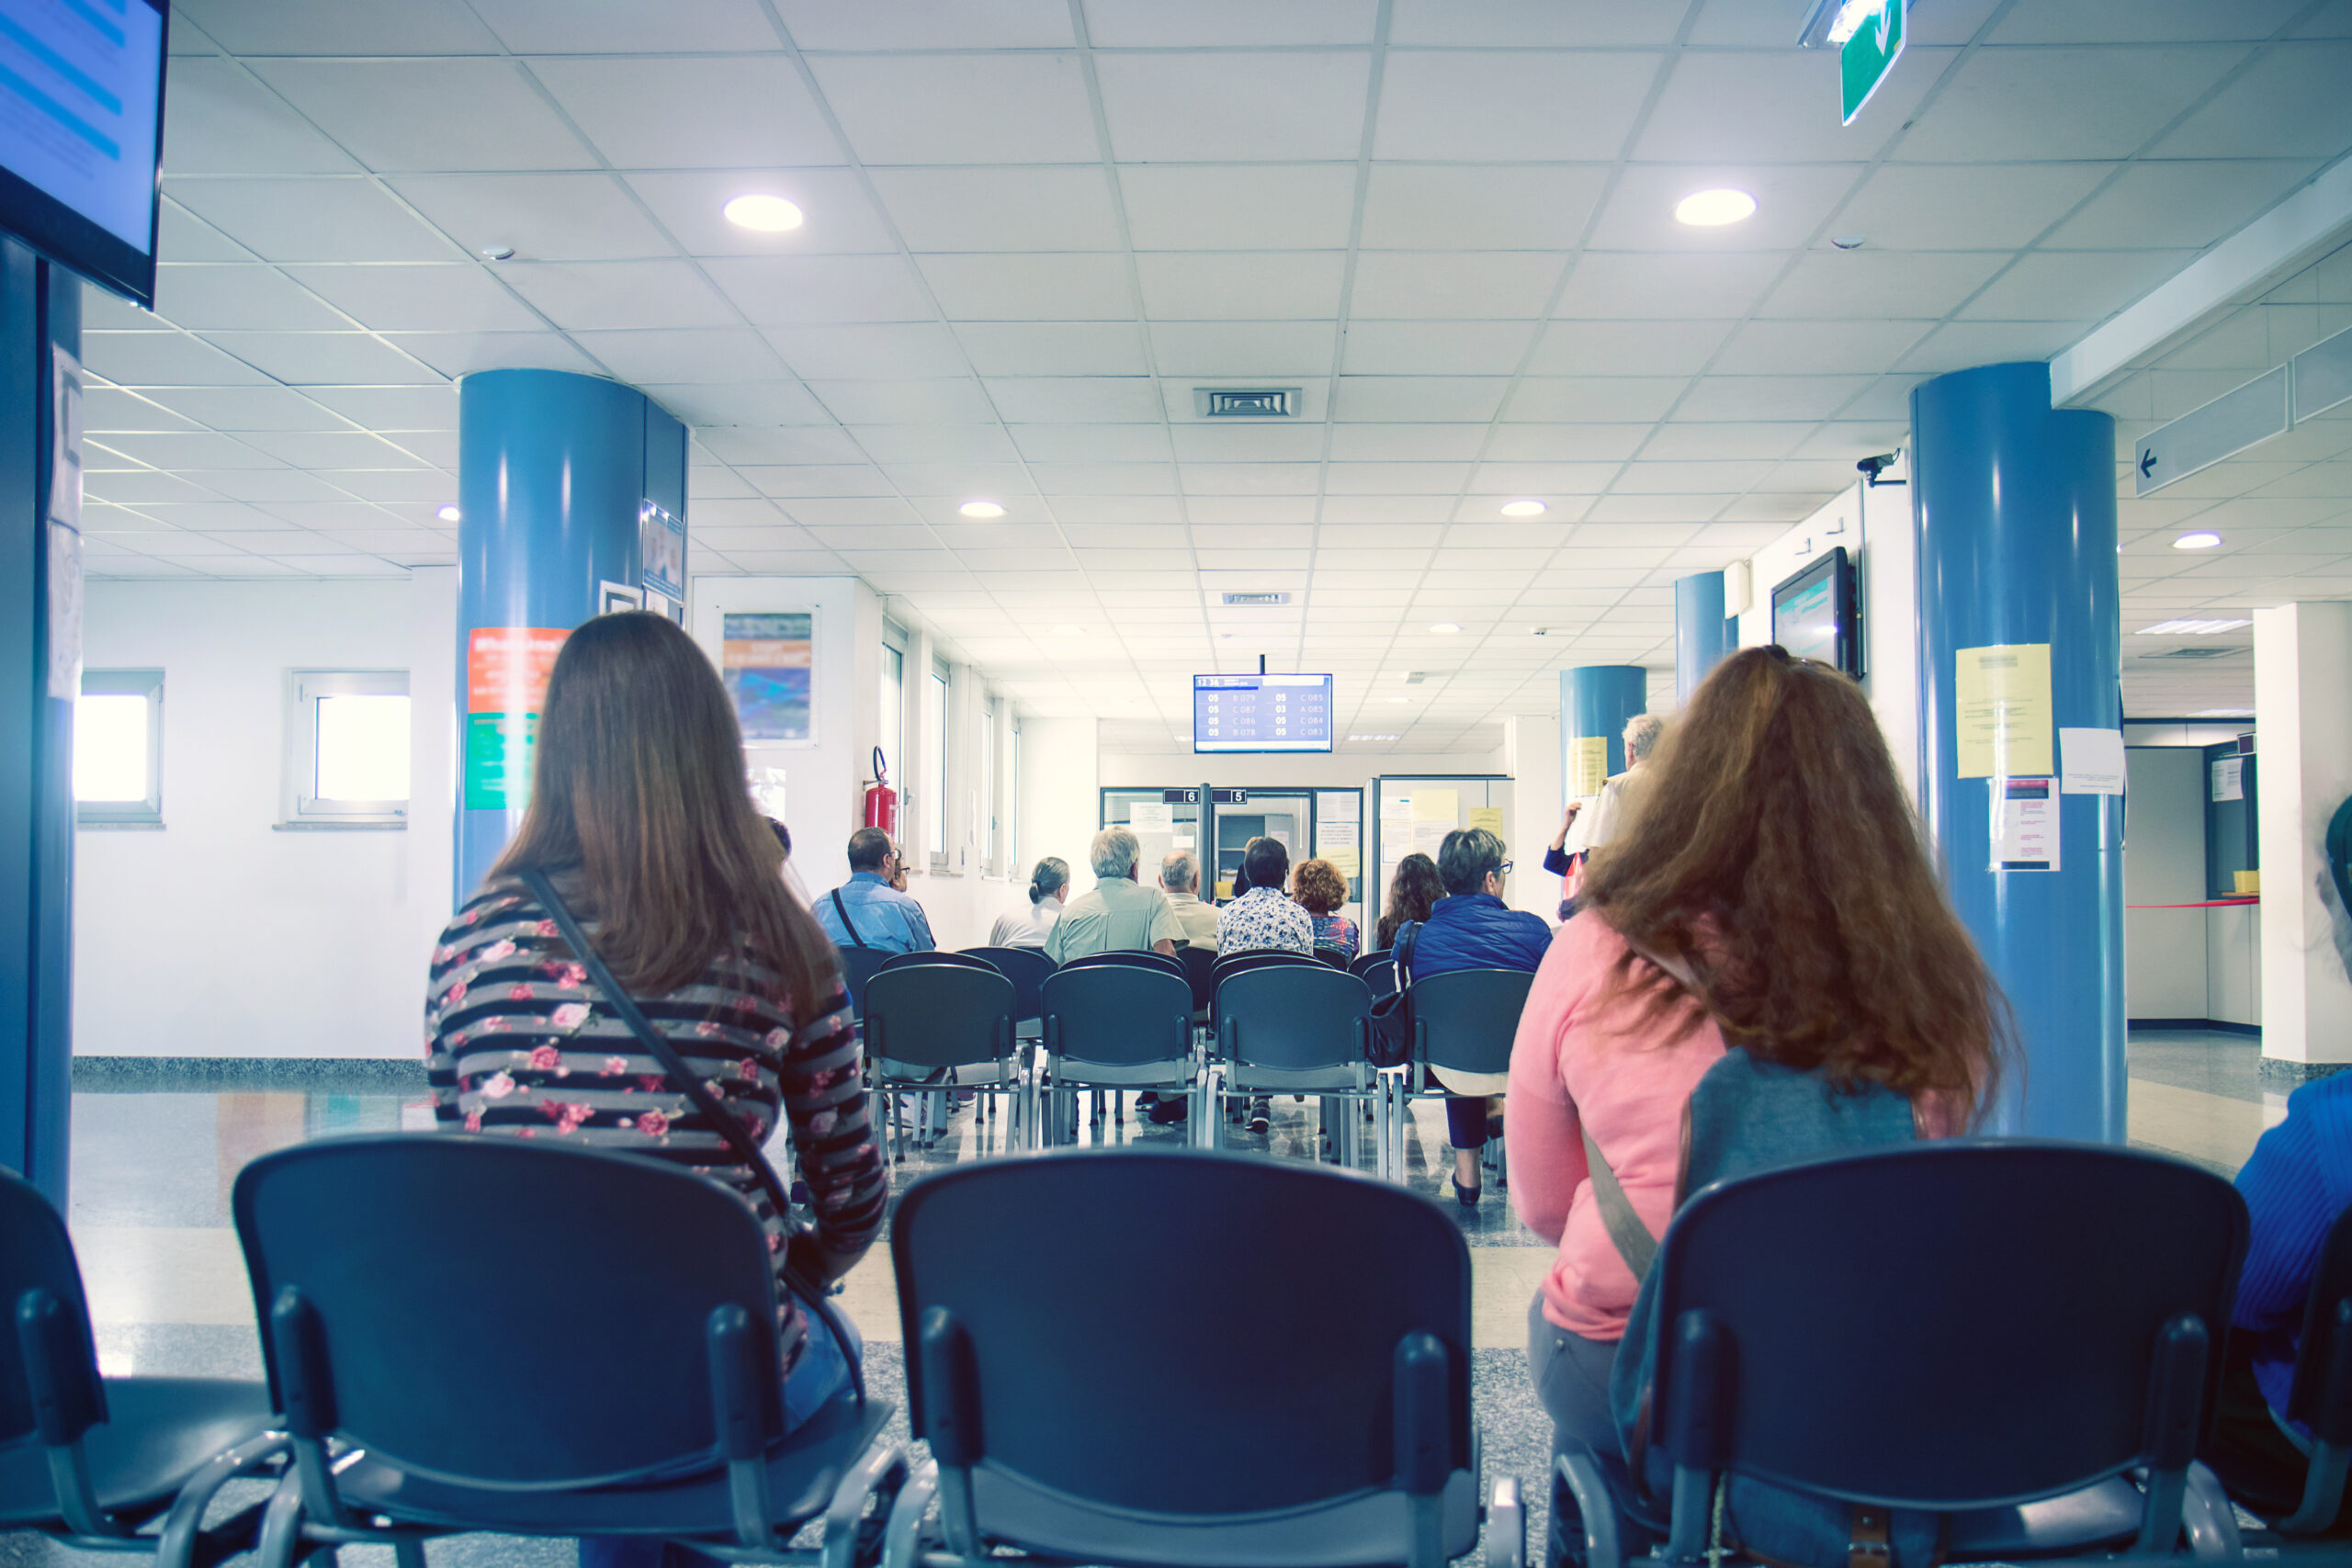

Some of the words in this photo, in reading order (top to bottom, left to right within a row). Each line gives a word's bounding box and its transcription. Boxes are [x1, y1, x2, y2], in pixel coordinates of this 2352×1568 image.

[1208, 694, 1219, 702] 05
[1275, 694, 1286, 702] 05
[1300, 694, 1306, 702] C
[1208, 705, 1219, 714] 05
[1208, 716, 1219, 725] 05
[1300, 716, 1306, 725] C
[1208, 728, 1219, 737] 05
[1275, 728, 1286, 737] 05
[1300, 728, 1306, 737] C
[1188, 792, 1195, 802] 6
[1235, 792, 1242, 802] 5
